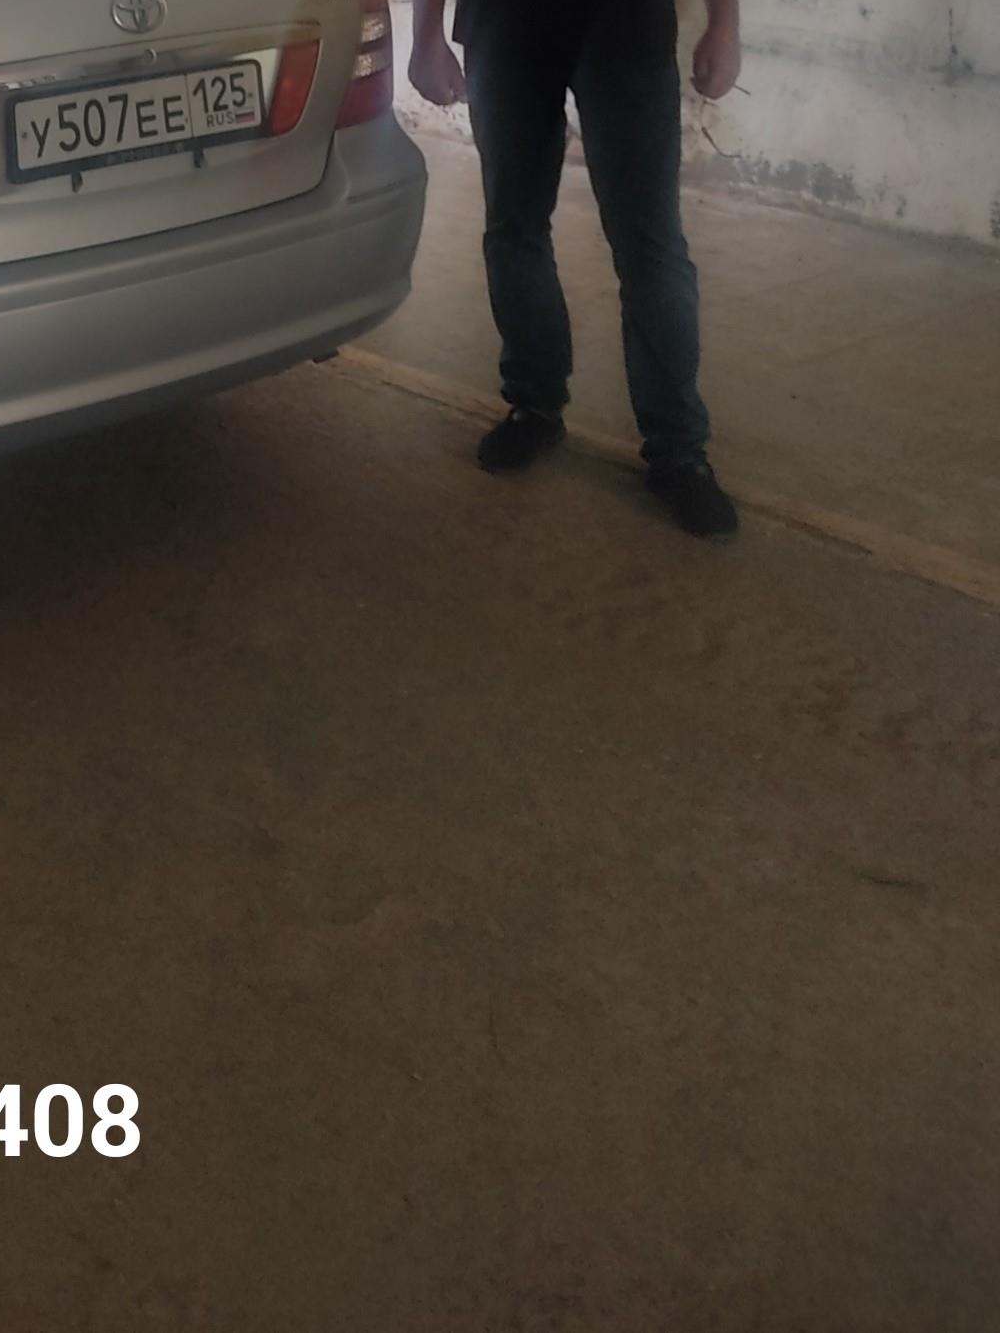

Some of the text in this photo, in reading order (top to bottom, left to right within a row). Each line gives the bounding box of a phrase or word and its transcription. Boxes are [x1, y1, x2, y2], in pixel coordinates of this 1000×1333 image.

[192, 72, 247, 115] 125
[30, 93, 186, 159] У507ЕЕ
[206, 110, 235, 129] RUS
